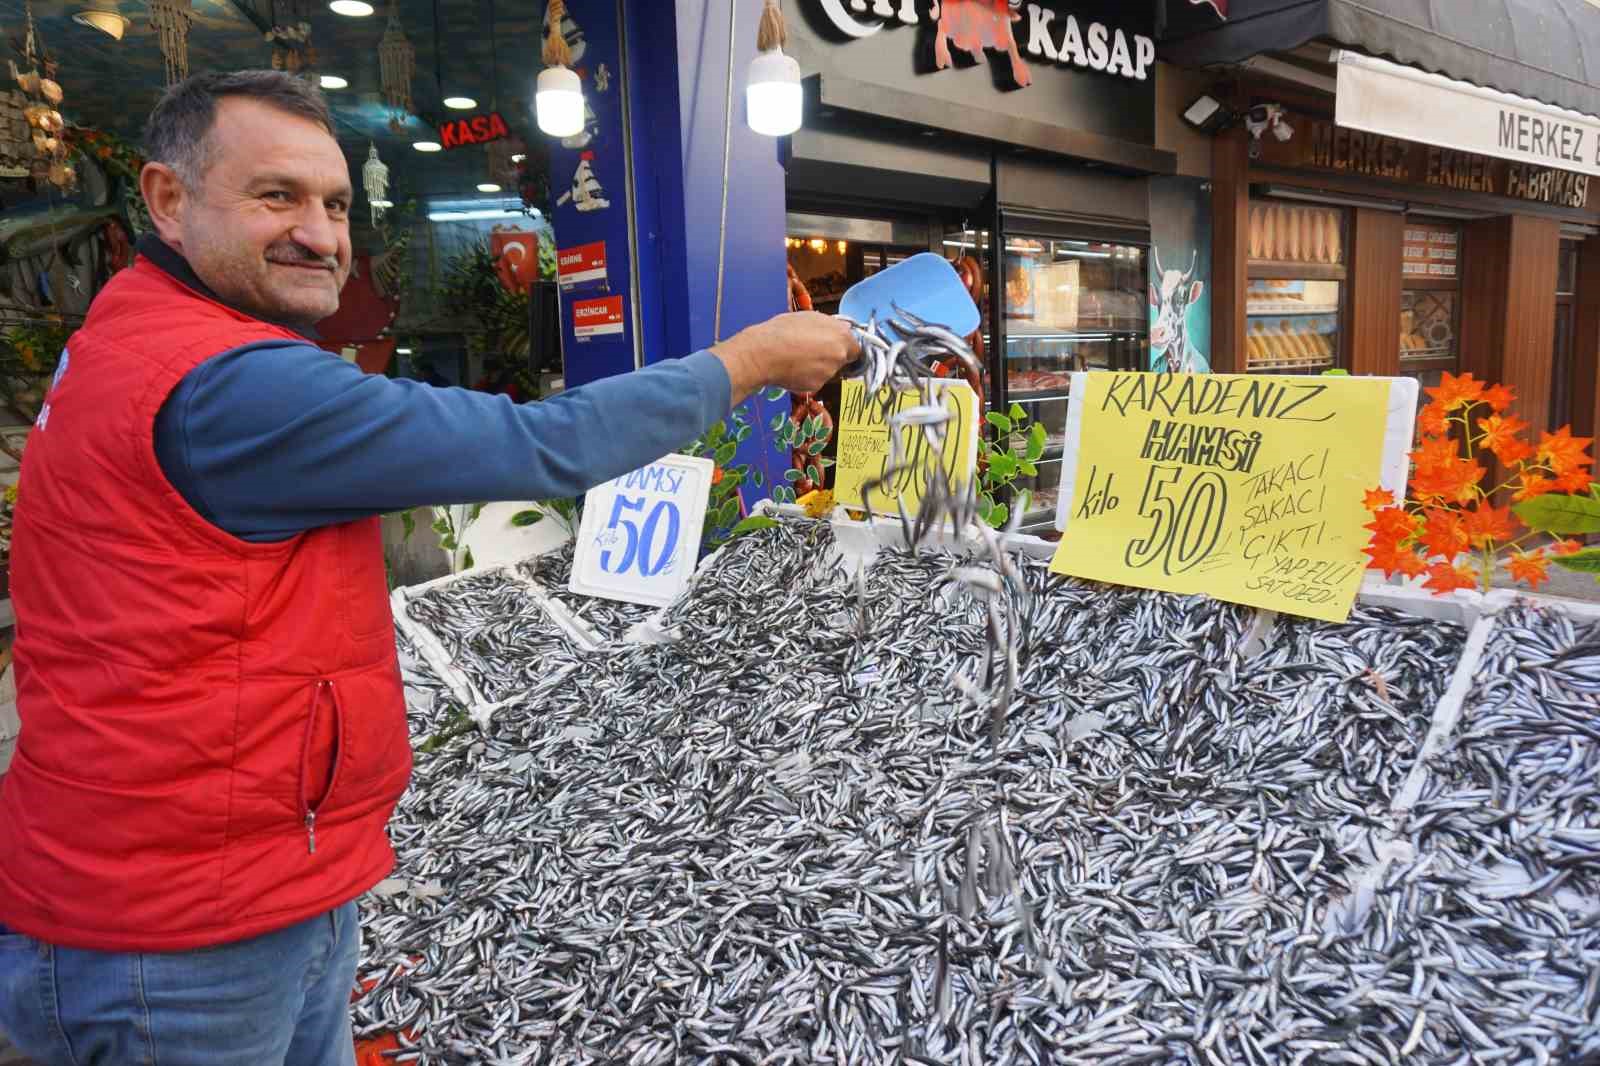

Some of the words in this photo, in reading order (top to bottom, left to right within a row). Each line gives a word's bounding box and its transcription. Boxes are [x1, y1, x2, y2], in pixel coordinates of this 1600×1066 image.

[1026, 3, 1155, 81] KASAP
[440, 112, 508, 149] KASA
[1498, 109, 1584, 163] MERKEZ
[1240, 448, 1329, 503] TAKACI
[599, 494, 681, 578] 50
[1125, 465, 1228, 577] 50
